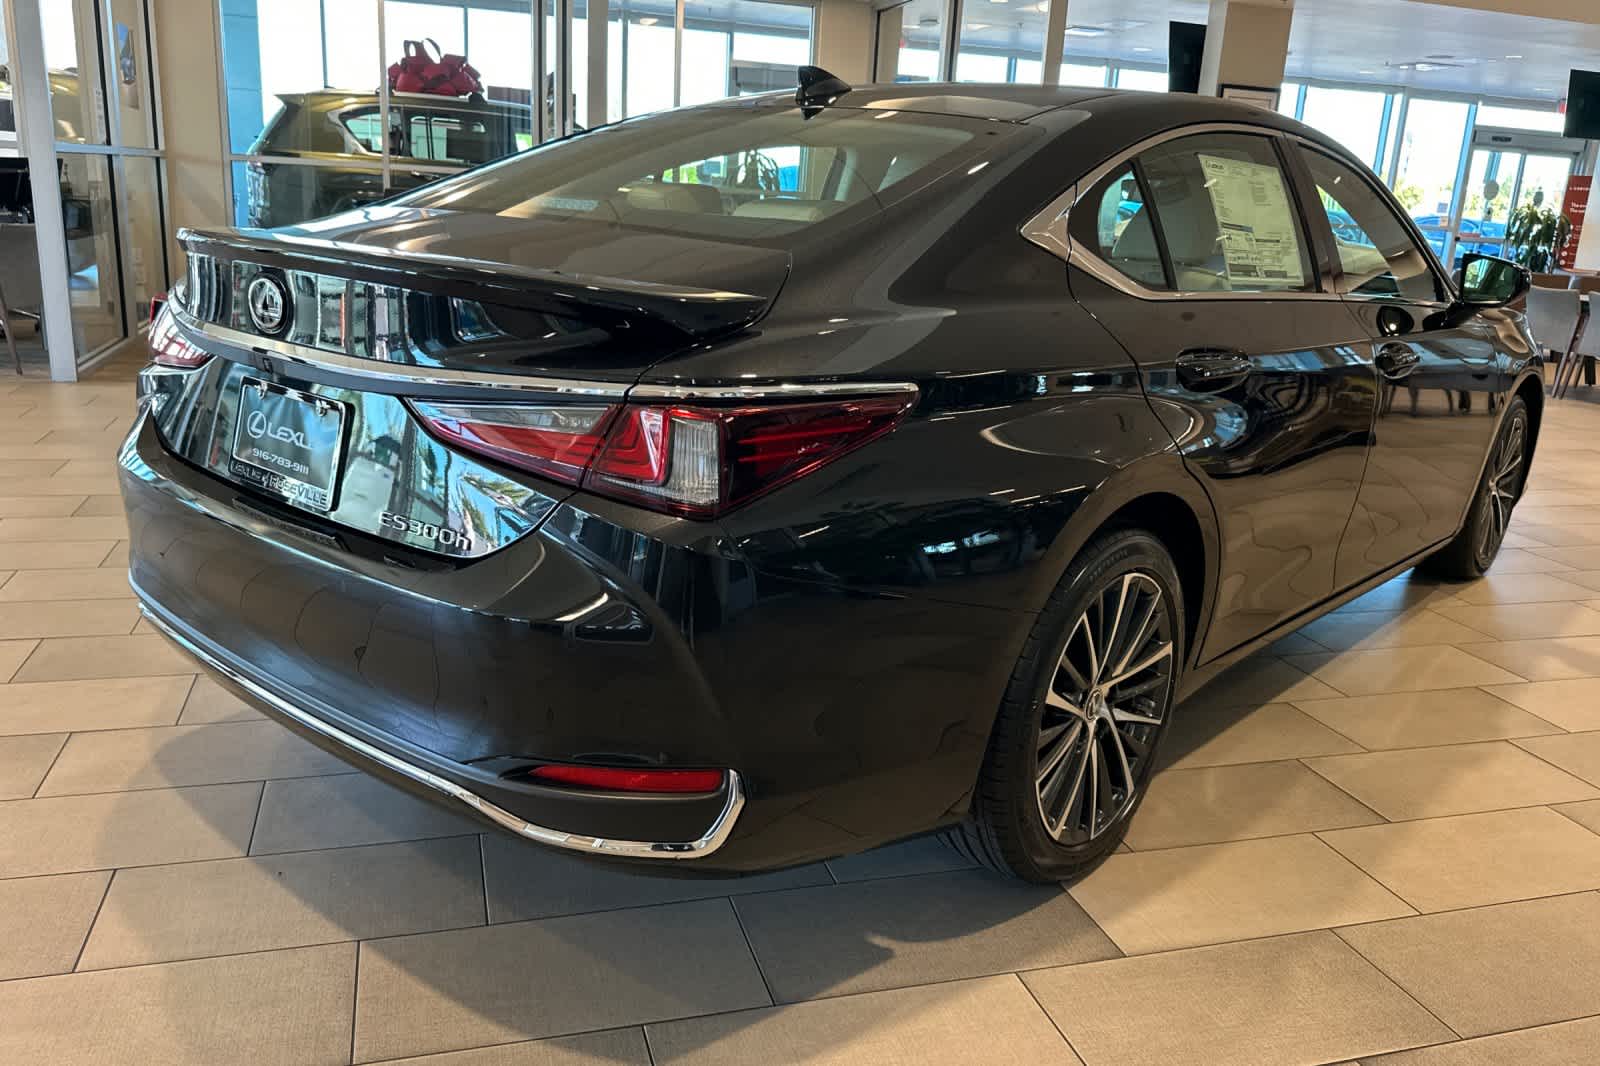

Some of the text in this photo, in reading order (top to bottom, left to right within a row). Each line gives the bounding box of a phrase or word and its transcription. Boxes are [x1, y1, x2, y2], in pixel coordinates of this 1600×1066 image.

[252, 448, 310, 475] 916-783-9111
[270, 474, 328, 505] ROSEVILLE
[378, 511, 472, 551] ES300h
